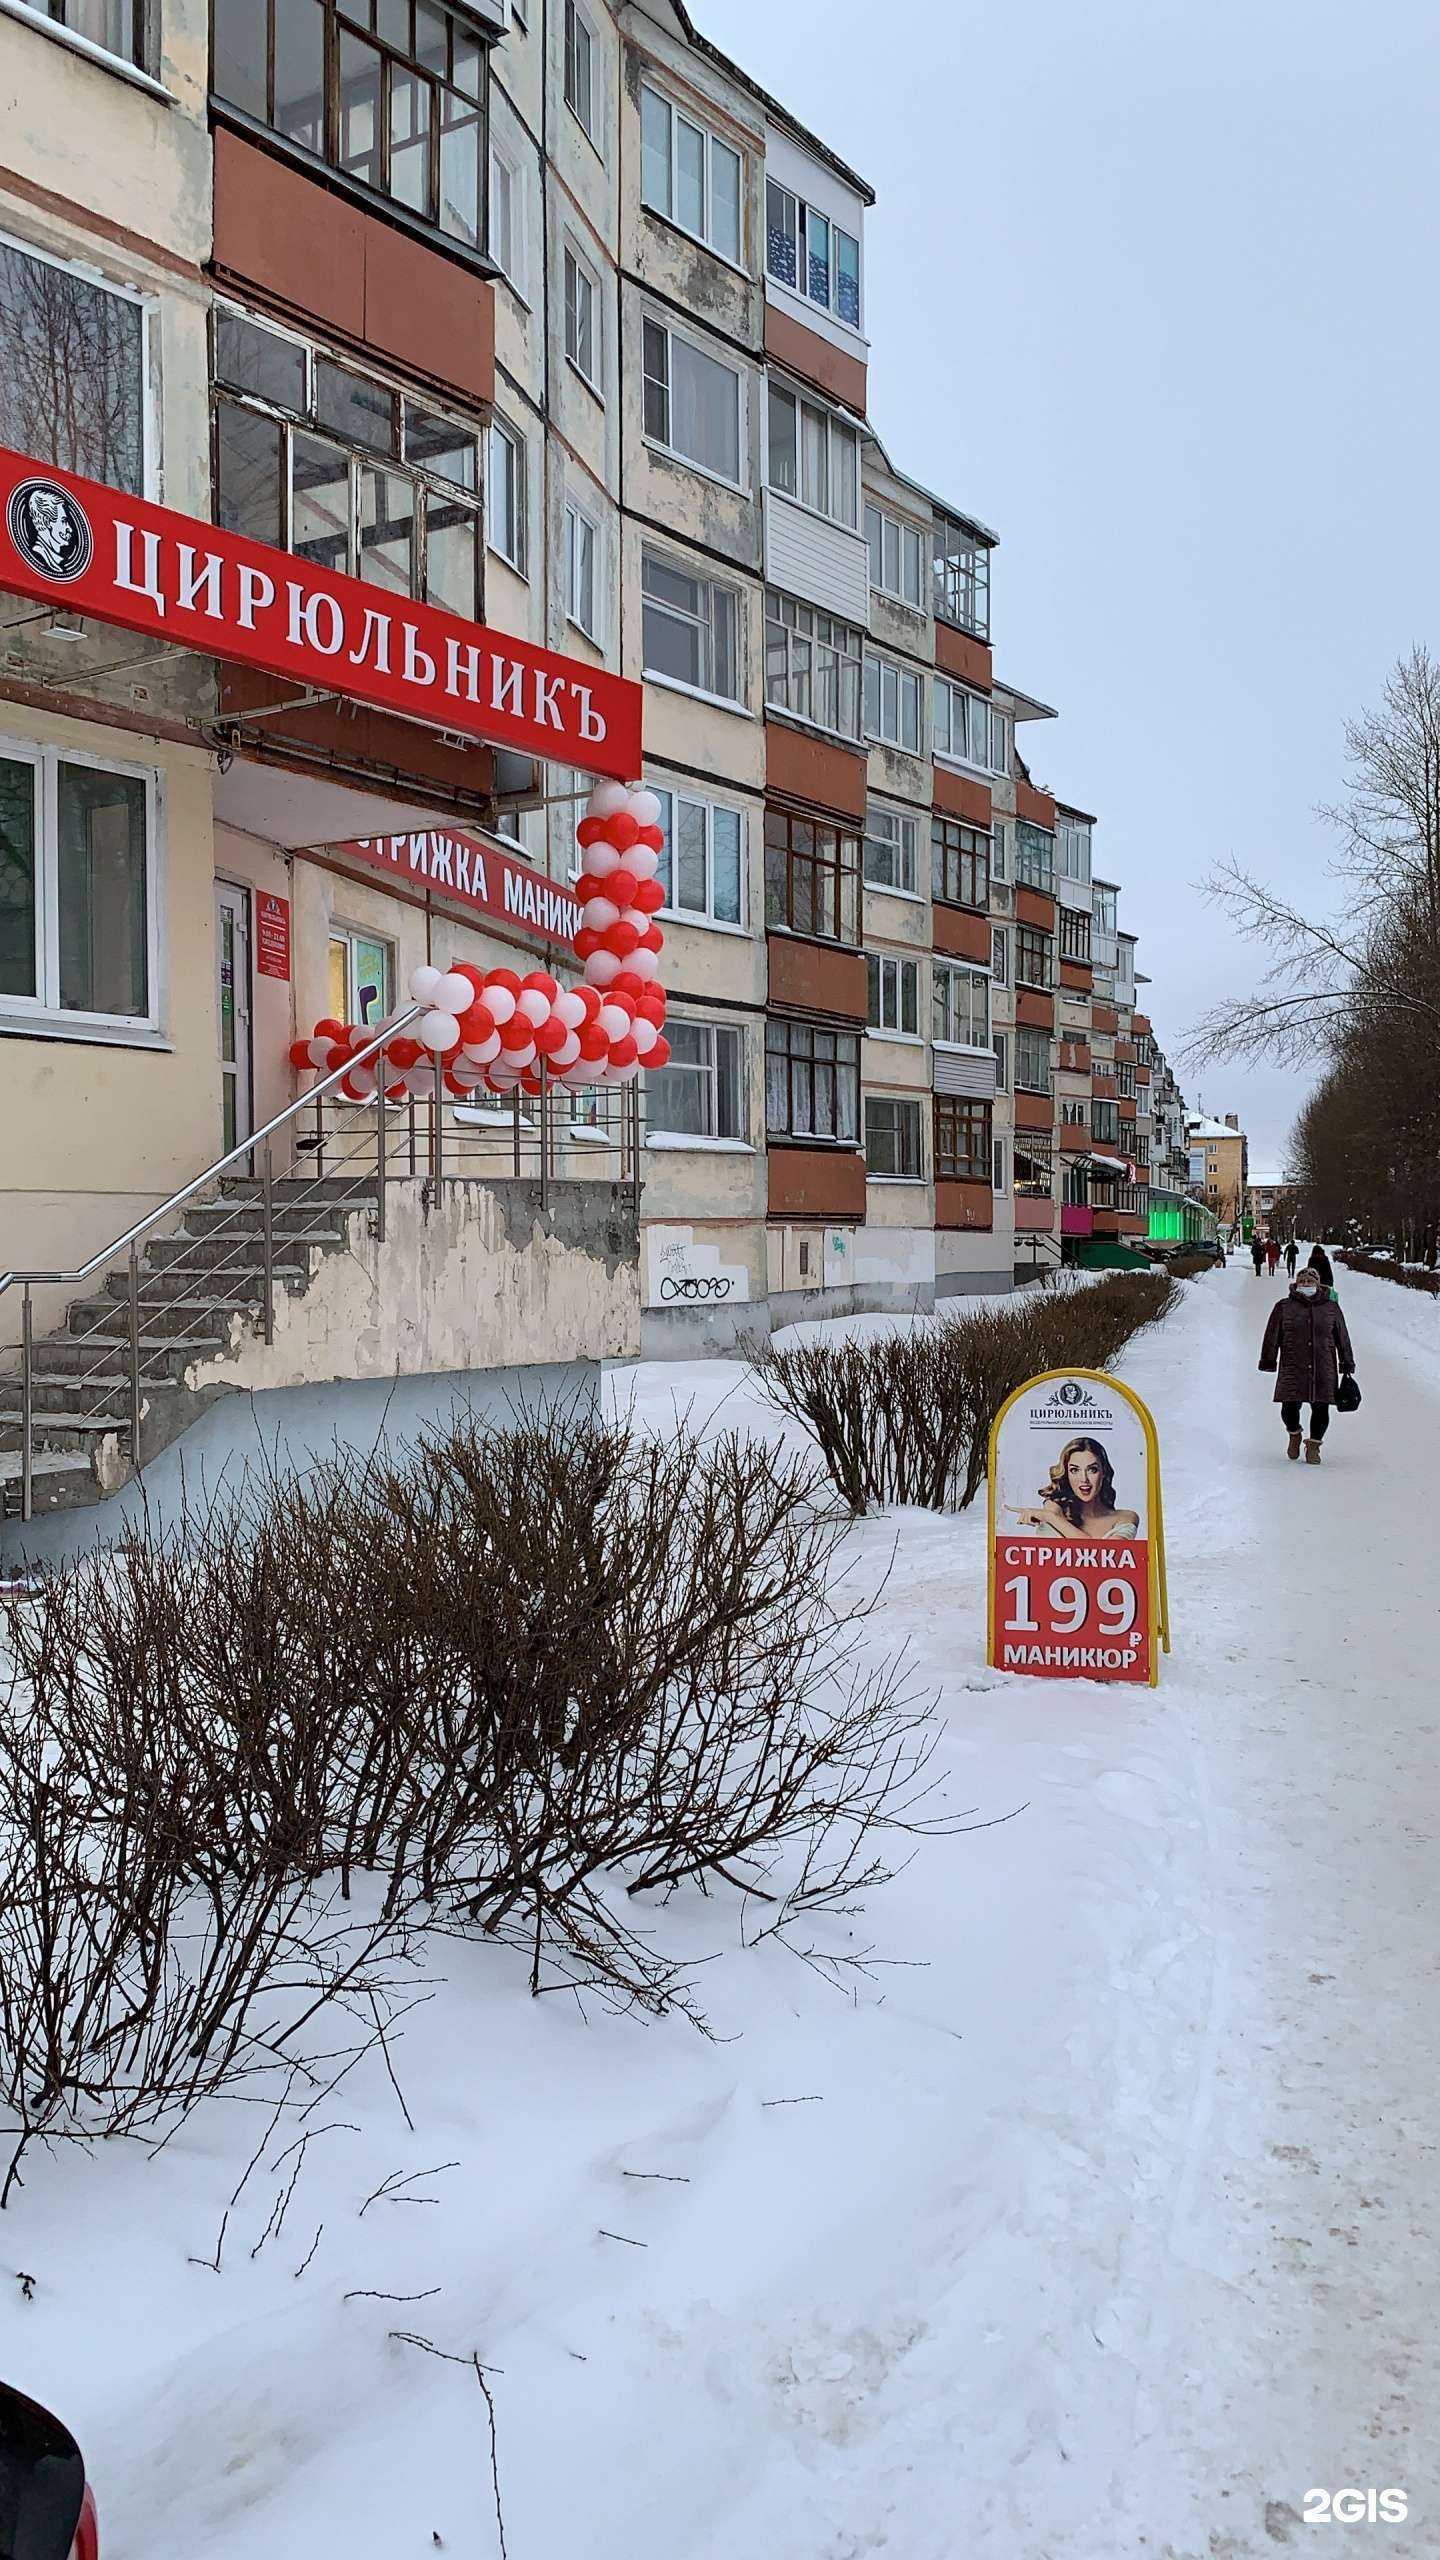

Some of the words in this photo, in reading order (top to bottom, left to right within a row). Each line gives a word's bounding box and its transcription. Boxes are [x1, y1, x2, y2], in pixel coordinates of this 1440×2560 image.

[113, 519, 608, 744] ЦИРЮЛЬНИКЪ
[358, 831, 488, 902] РИЖКА
[1030, 1409, 1113, 1419] ЦИРЮЛЬНИКЪ
[1005, 1546, 1136, 1569] СТРИЖКА
[1004, 1644, 1138, 1669] МАНИКЮР
